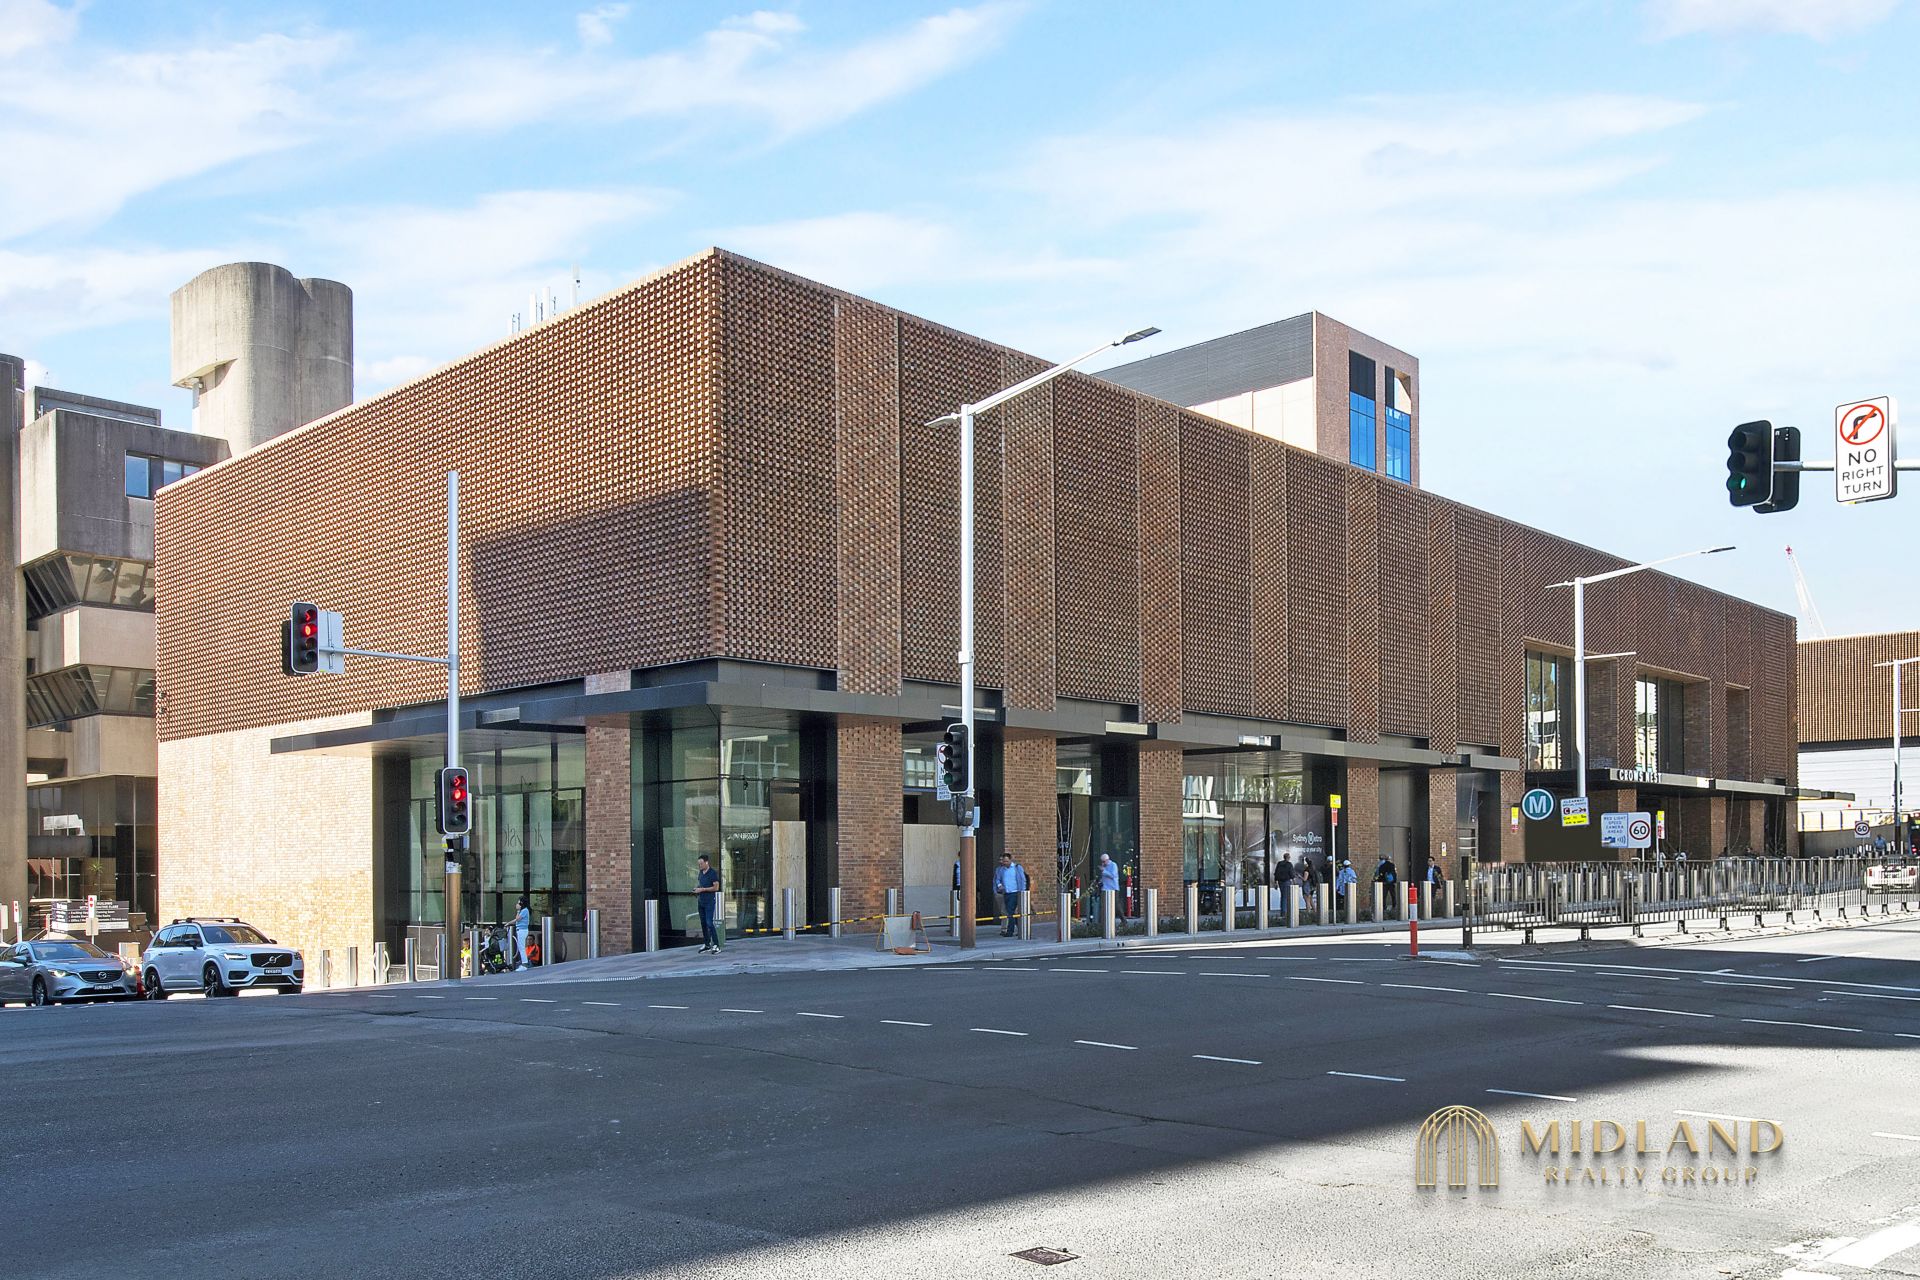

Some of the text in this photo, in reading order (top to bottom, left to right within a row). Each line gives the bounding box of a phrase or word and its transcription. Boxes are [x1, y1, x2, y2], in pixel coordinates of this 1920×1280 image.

[1849, 448, 1876, 466] NO
[1842, 465, 1884, 481] RIGHT
[1844, 480, 1882, 494] TURN
[1619, 769, 1661, 784] CROWS NEST
[1529, 796, 1547, 814] M
[1633, 826, 1647, 835] 60
[1292, 834, 1307, 844] Sydney
